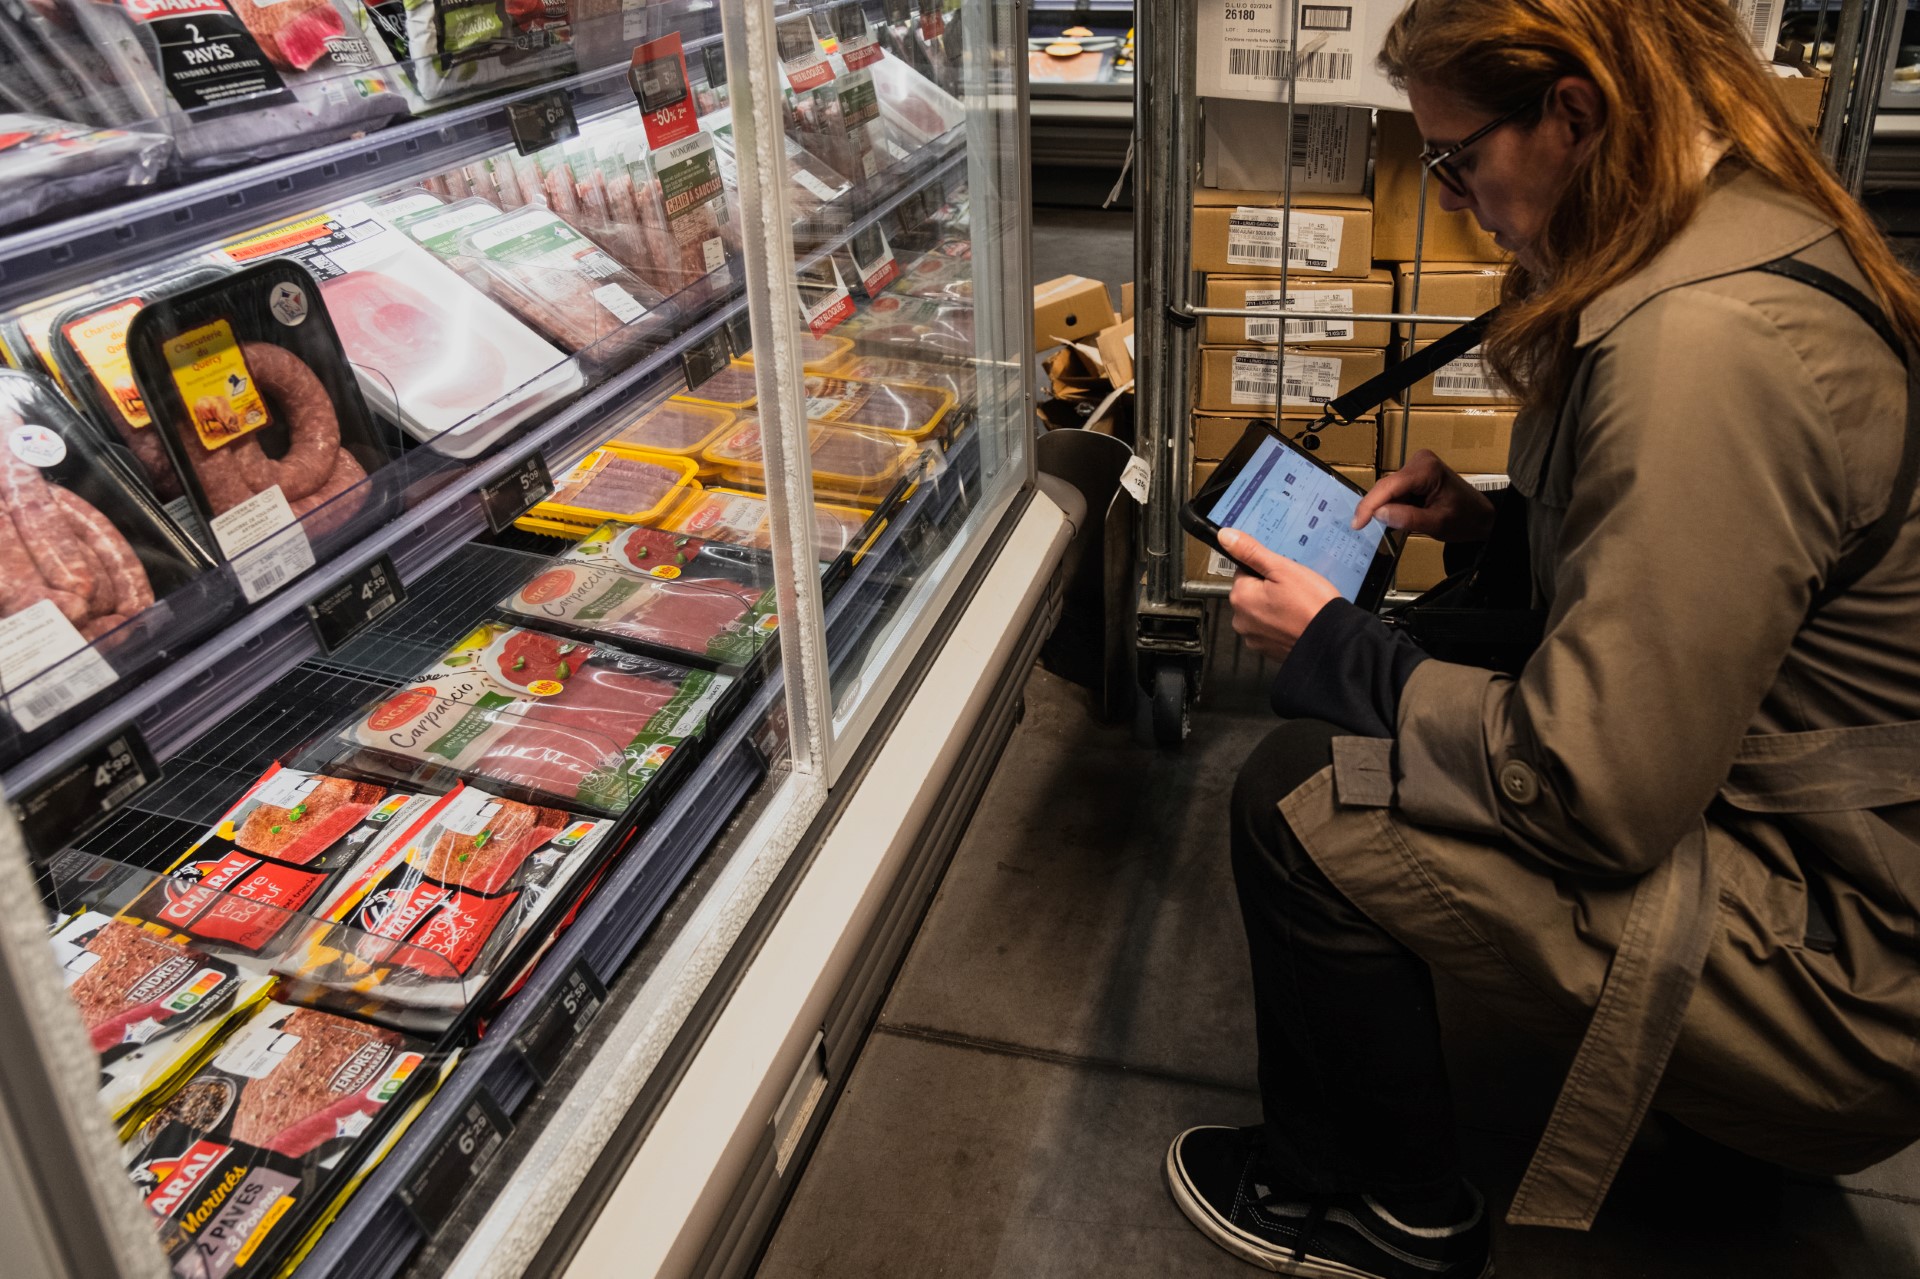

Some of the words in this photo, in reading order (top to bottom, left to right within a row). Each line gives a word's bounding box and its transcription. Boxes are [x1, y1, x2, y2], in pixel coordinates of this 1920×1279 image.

[185, 24, 205, 44] 2
[1225, 9, 1256, 21] 26180
[182, 43, 235, 65] PAVÉS
[670, 140, 699, 159] MONOPRIX
[823, 300, 846, 322] BLOQUÉS
[174, 328, 222, 354] Charcuterie
[191, 354, 222, 373] Quercy
[541, 567, 607, 617] Carpaccio
[375, 689, 430, 728] BIGARD
[389, 682, 474, 749] Carpaccio
[166, 857, 251, 920] CHARAL
[206, 874, 269, 922] Tendre
[127, 955, 189, 1004] TENDRETÉ
[331, 1038, 384, 1094] TENDRETÉ
[344, 1043, 392, 1096] INCOMPARABLE
[150, 1149, 220, 1216] ARAL
[179, 1165, 249, 1235] Marinés
[201, 1241, 218, 1257] 2
[210, 1180, 264, 1241] PAVÉS
[226, 1235, 241, 1251] 3
